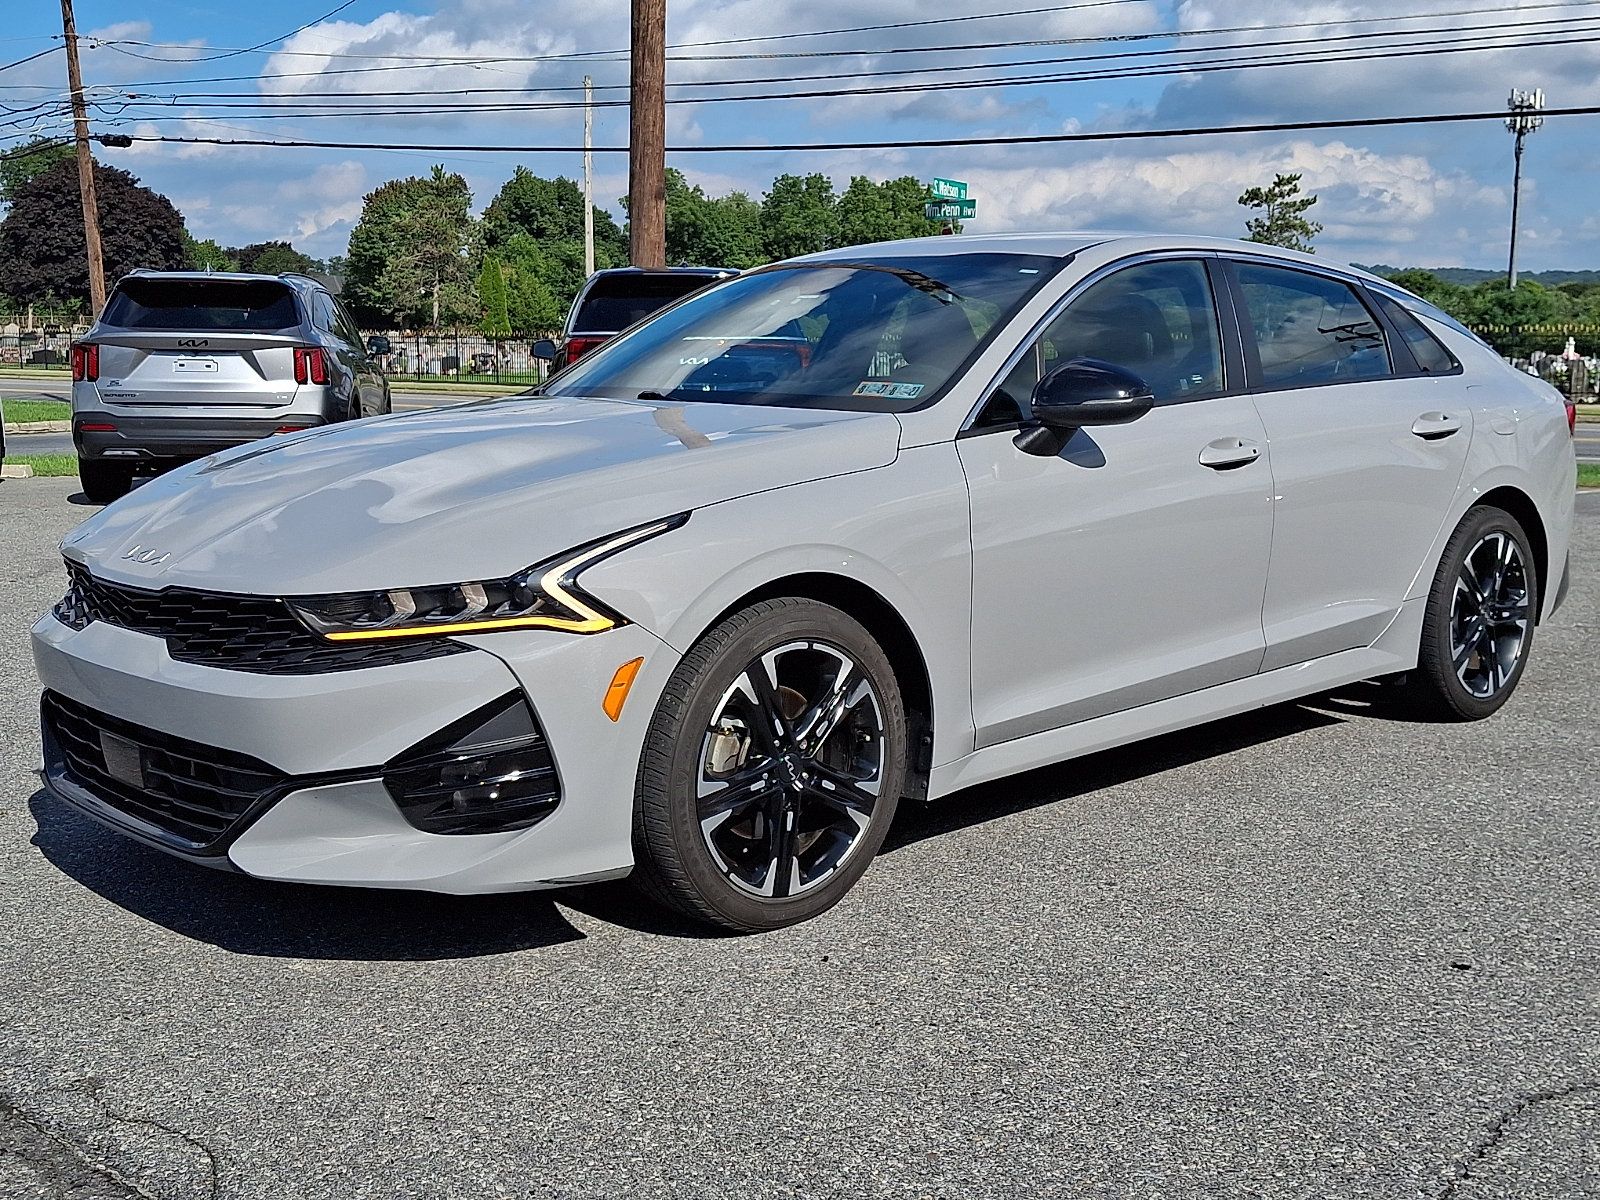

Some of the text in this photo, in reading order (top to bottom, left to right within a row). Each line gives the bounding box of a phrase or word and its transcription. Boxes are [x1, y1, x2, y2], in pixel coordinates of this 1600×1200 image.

[939, 180, 959, 198] Watson
[941, 203, 960, 217] Penn
[963, 206, 976, 217] Hwy
[178, 339, 208, 347] KIA
